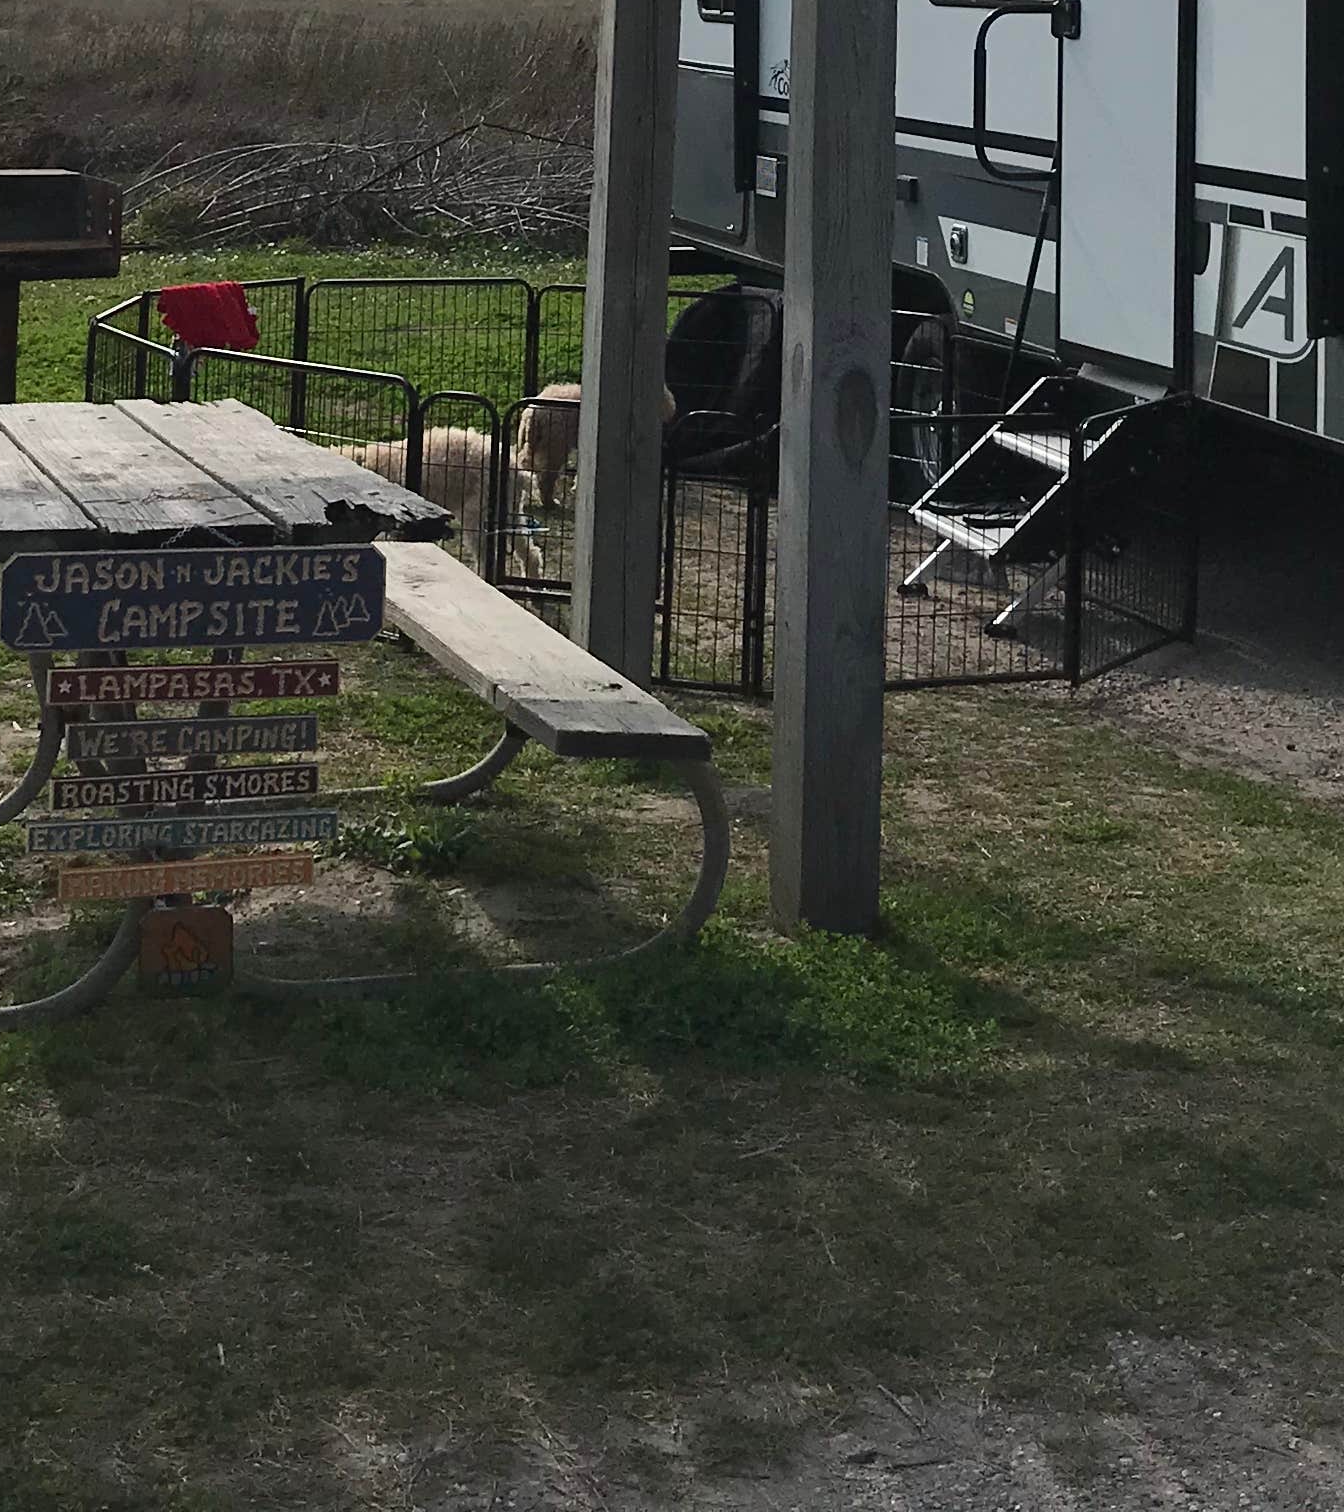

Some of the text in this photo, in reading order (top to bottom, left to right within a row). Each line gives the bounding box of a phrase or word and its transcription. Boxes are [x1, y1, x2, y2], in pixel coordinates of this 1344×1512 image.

[34, 557, 165, 594] JASON
[203, 552, 361, 587] JACKIE'S
[97, 598, 301, 643] CAMPSITE
[76, 666, 316, 701] LAMPASAS, TX
[77, 721, 308, 758] WE'RE CAMPING!
[61, 768, 312, 809] ROASTING S'MORES
[31, 815, 334, 852] EXPLORING STARGAZING
